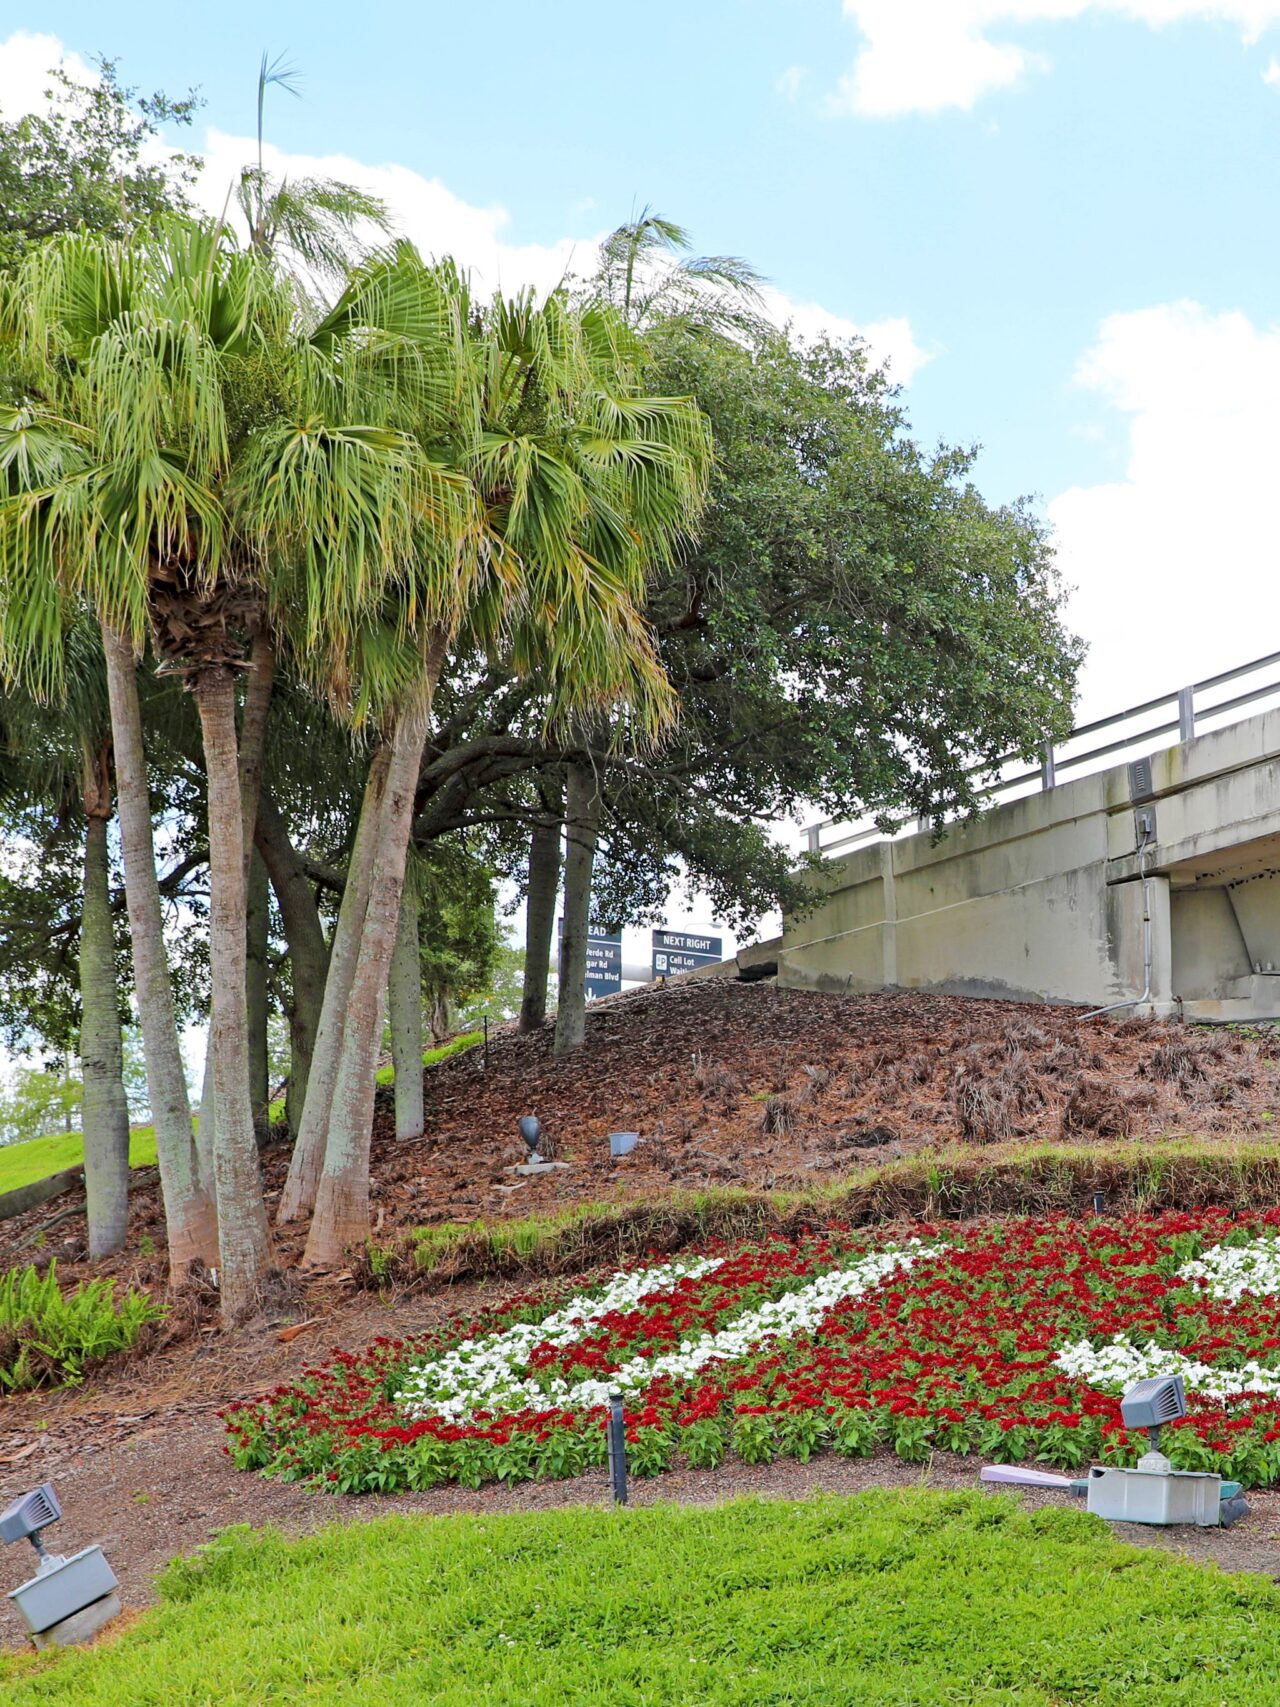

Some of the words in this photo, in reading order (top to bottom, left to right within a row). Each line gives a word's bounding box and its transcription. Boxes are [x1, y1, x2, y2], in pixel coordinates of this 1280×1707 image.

[588, 925, 607, 937] EAD
[663, 935, 685, 947] NEXT
[686, 937, 711, 950] RIGHT
[605, 949, 614, 959] Rd
[599, 960, 608, 969] Rd
[669, 955, 683, 965] Cell
[683, 957, 695, 967] Lot
[605, 972, 620, 982] Blvd
